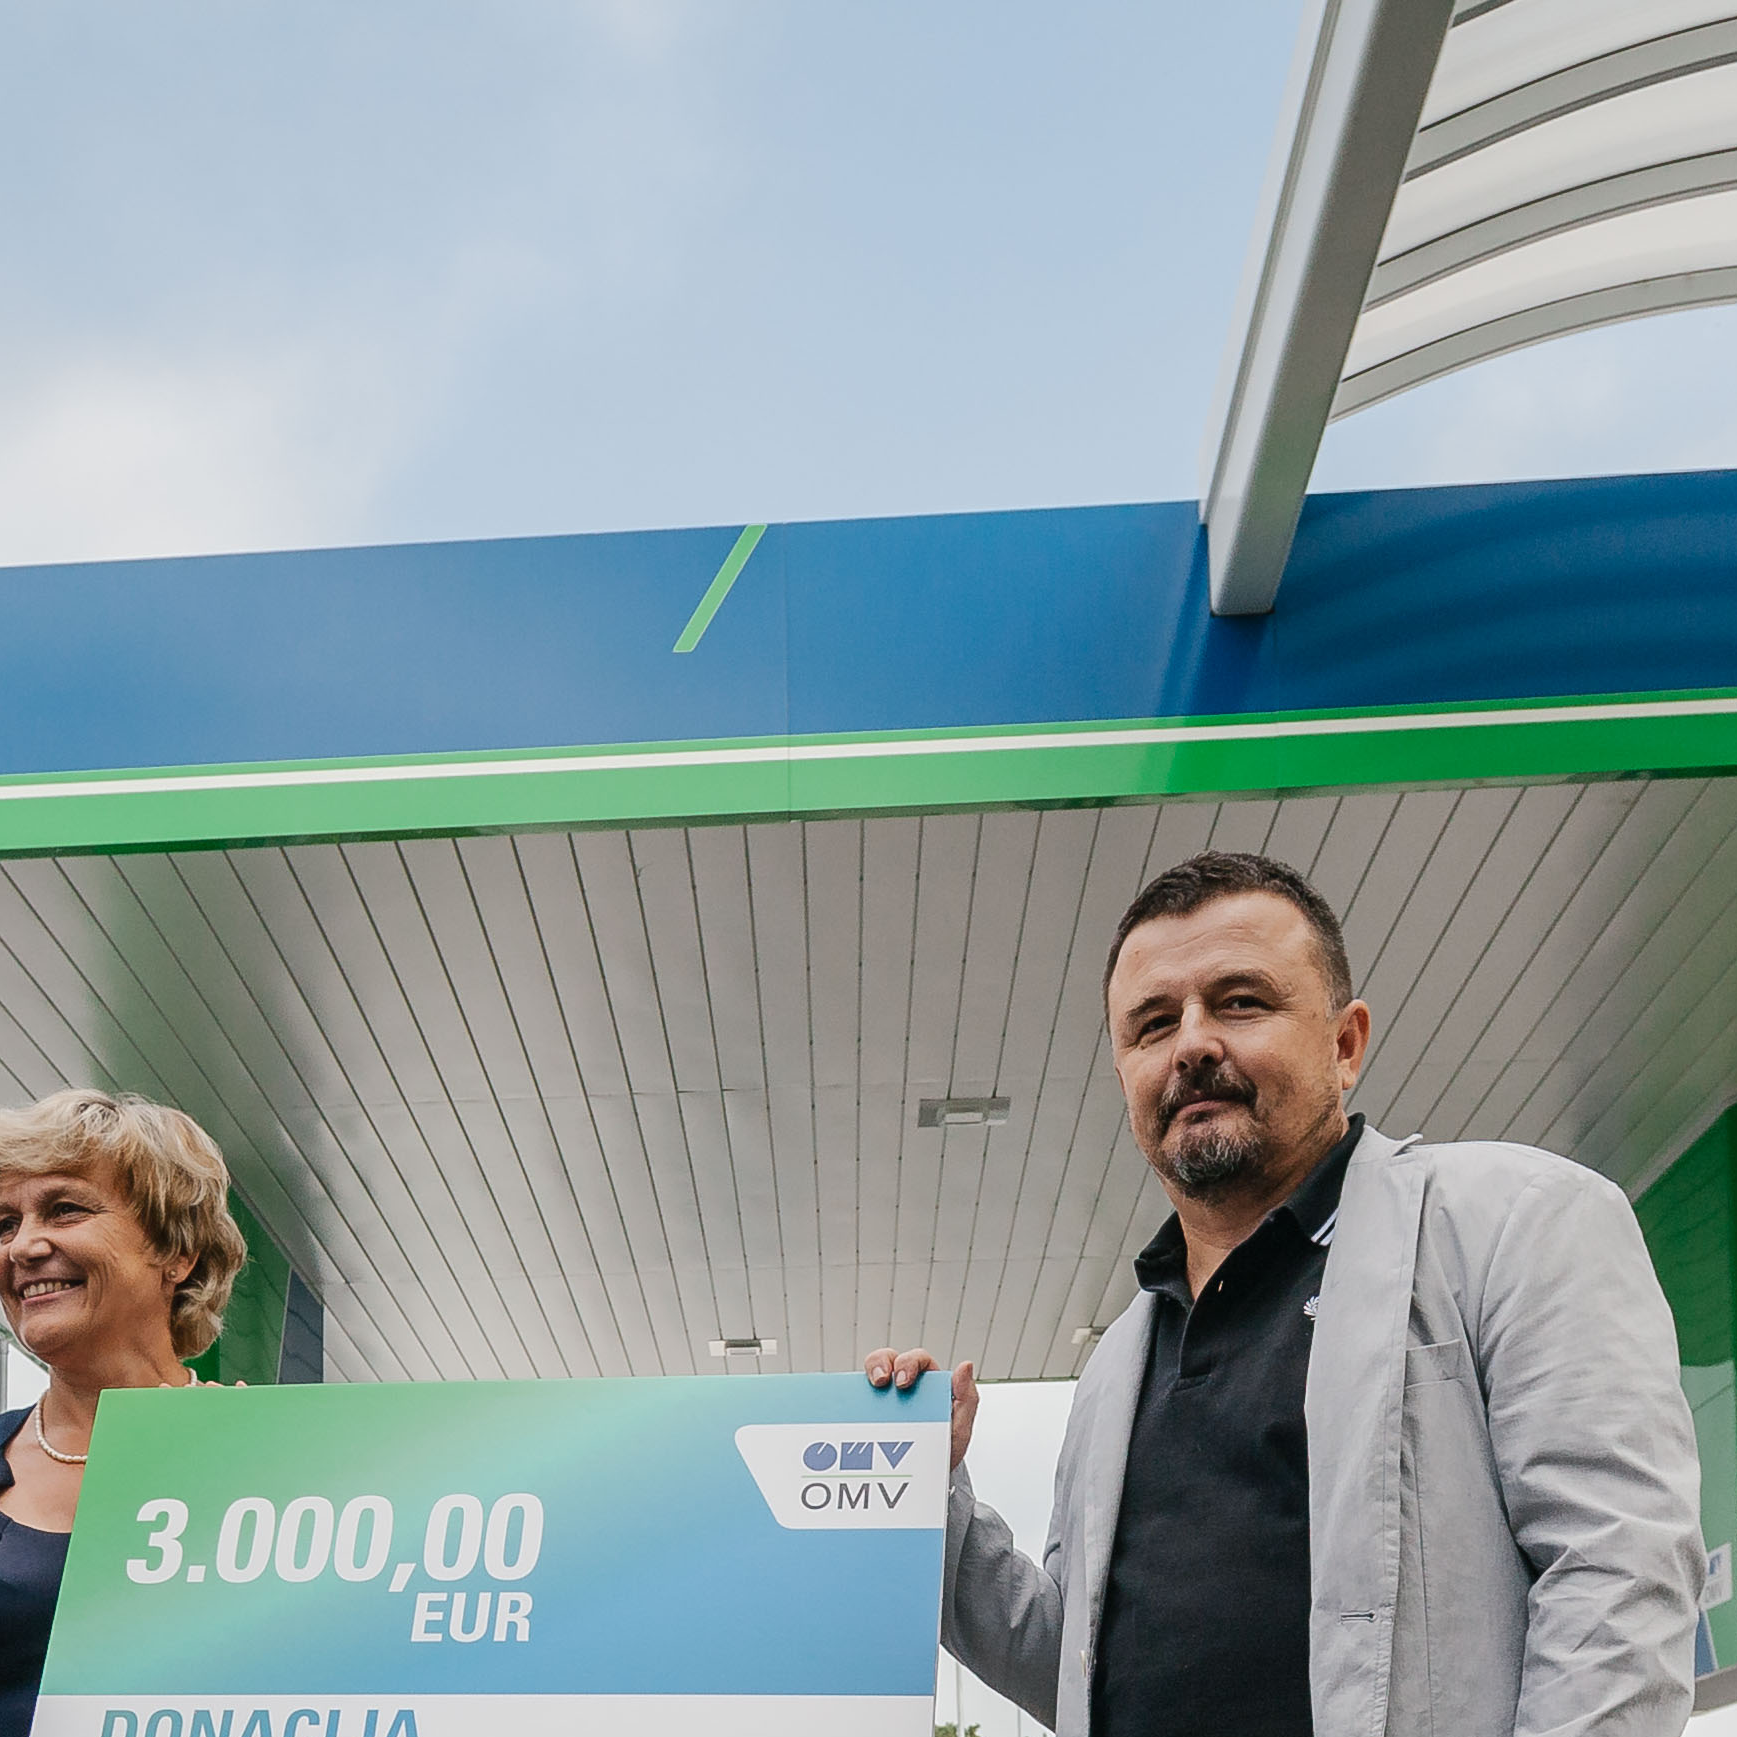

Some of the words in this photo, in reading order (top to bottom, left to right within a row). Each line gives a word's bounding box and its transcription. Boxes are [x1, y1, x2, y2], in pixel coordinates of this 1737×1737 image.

[801, 1482, 909, 1510] OMV
[126, 1492, 543, 1591] 3.000,00
[411, 1591, 533, 1643] EUR
